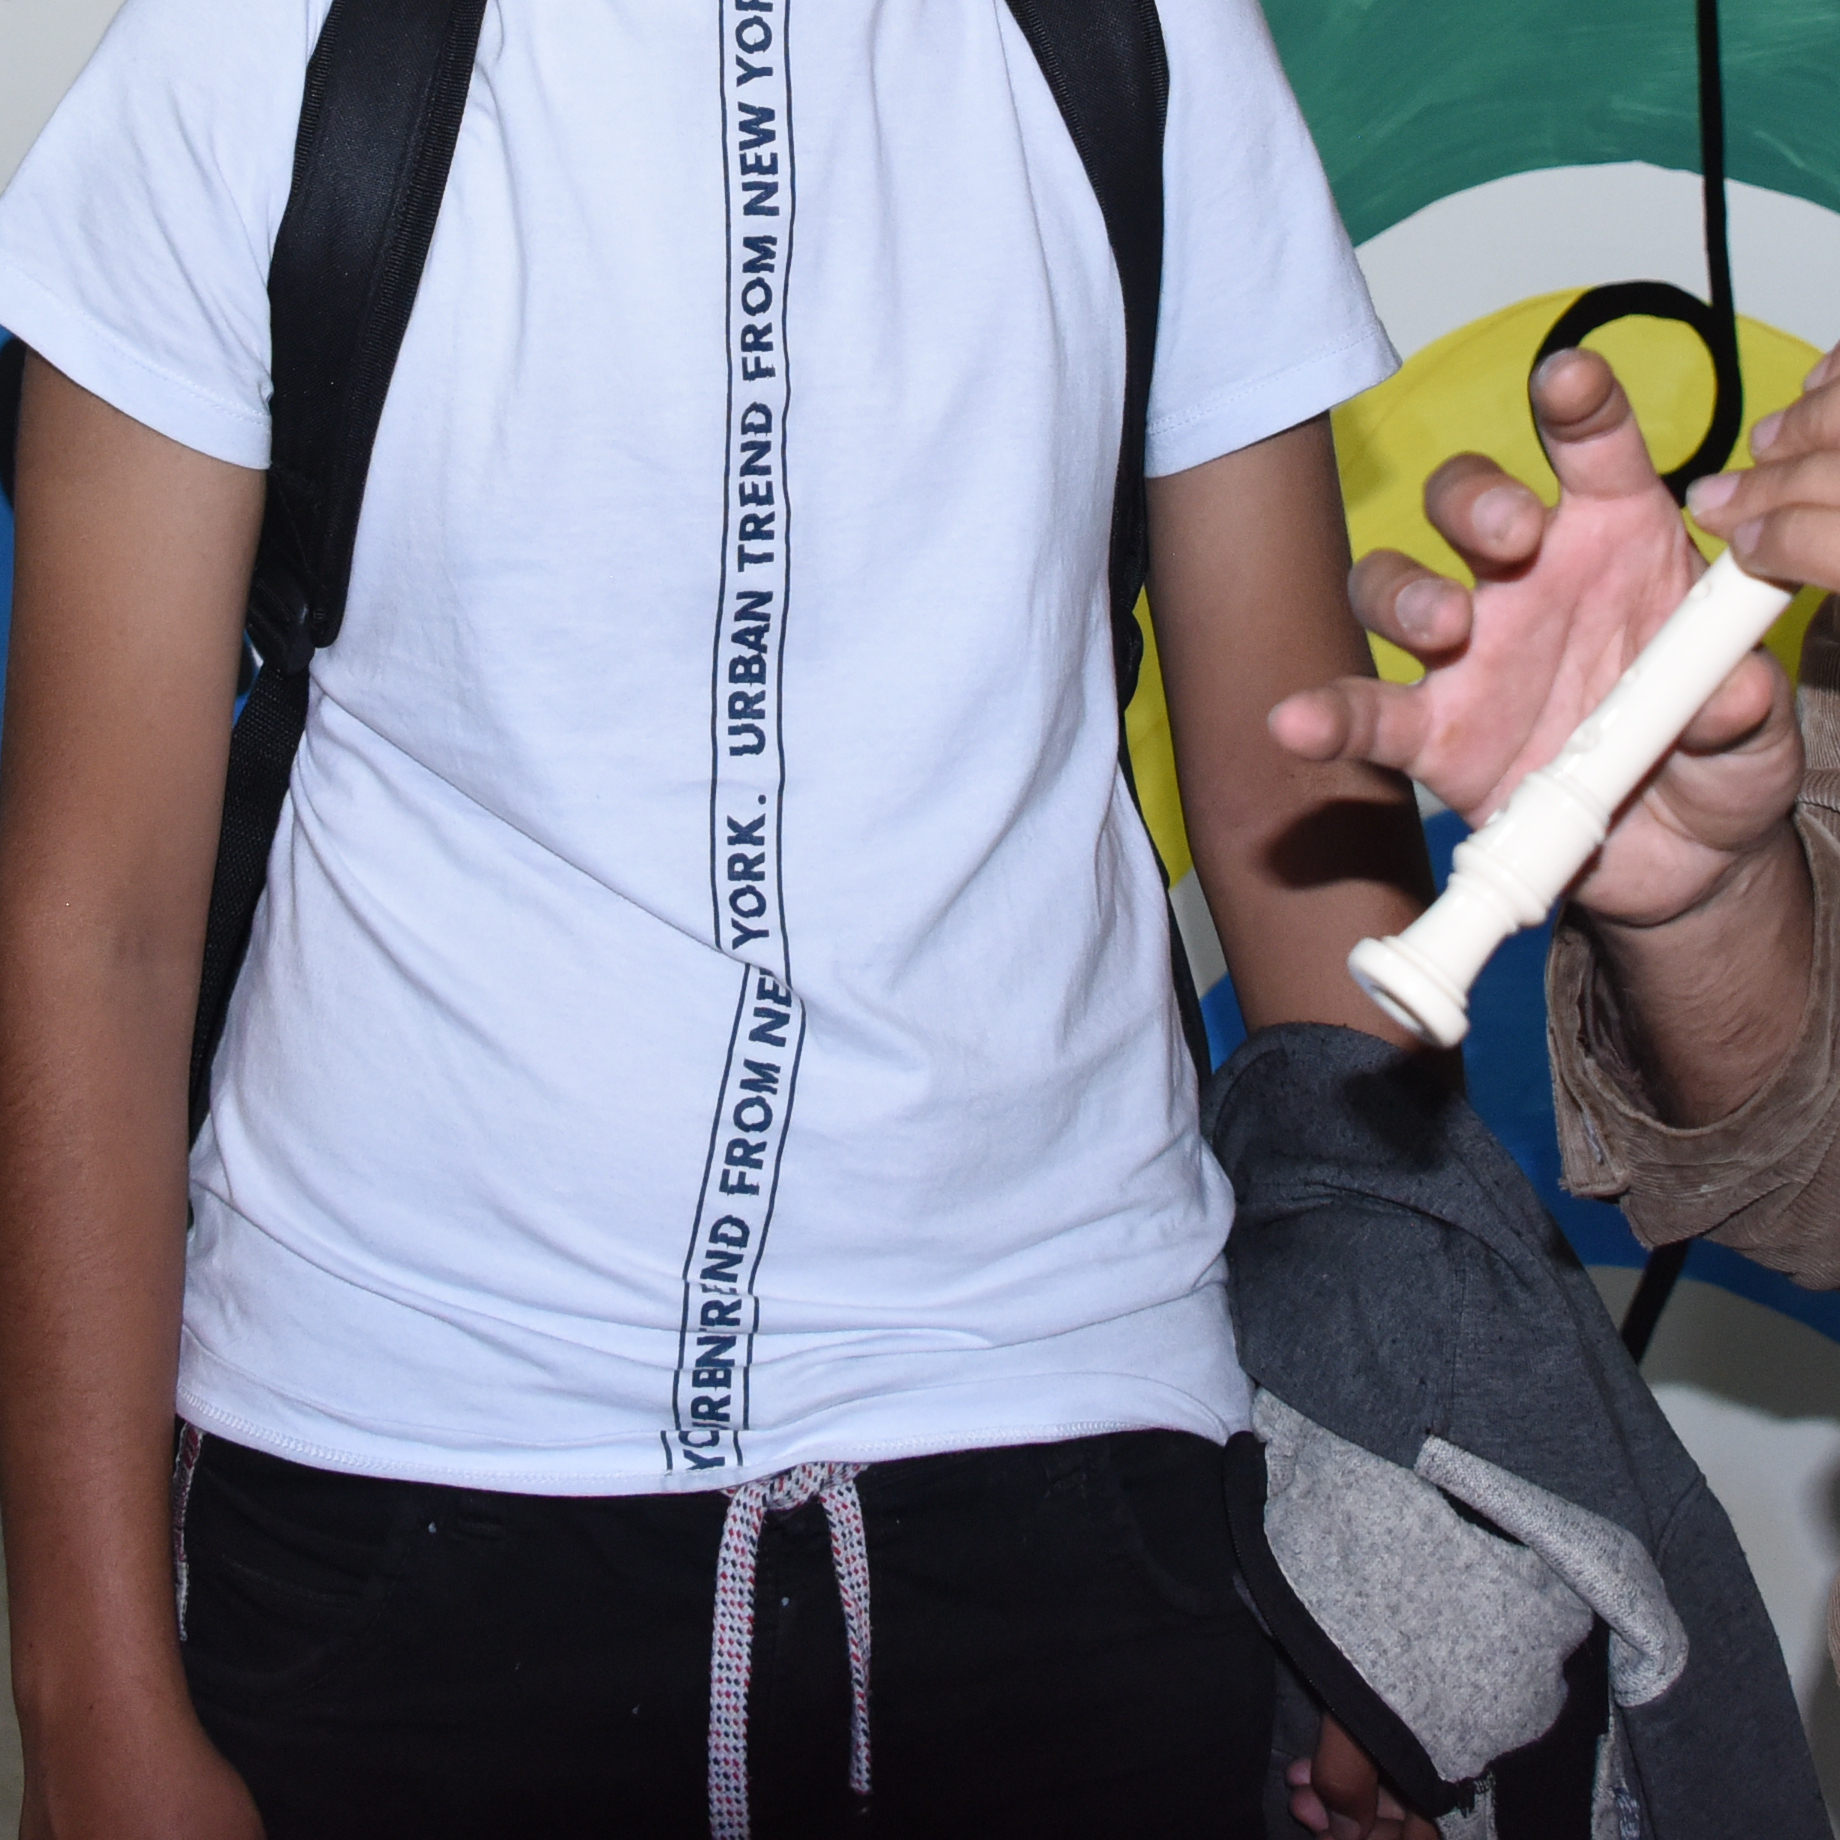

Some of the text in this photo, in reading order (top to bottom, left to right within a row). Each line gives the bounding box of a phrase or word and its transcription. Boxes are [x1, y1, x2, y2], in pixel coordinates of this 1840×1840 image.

[738, 102, 780, 217] NEW
[741, 236, 778, 382] FROM
[738, 402, 776, 573] TREND
[728, 591, 774, 757] URBAN
[749, 967, 793, 1048] NE
[719, 1059, 781, 1196] FROM
